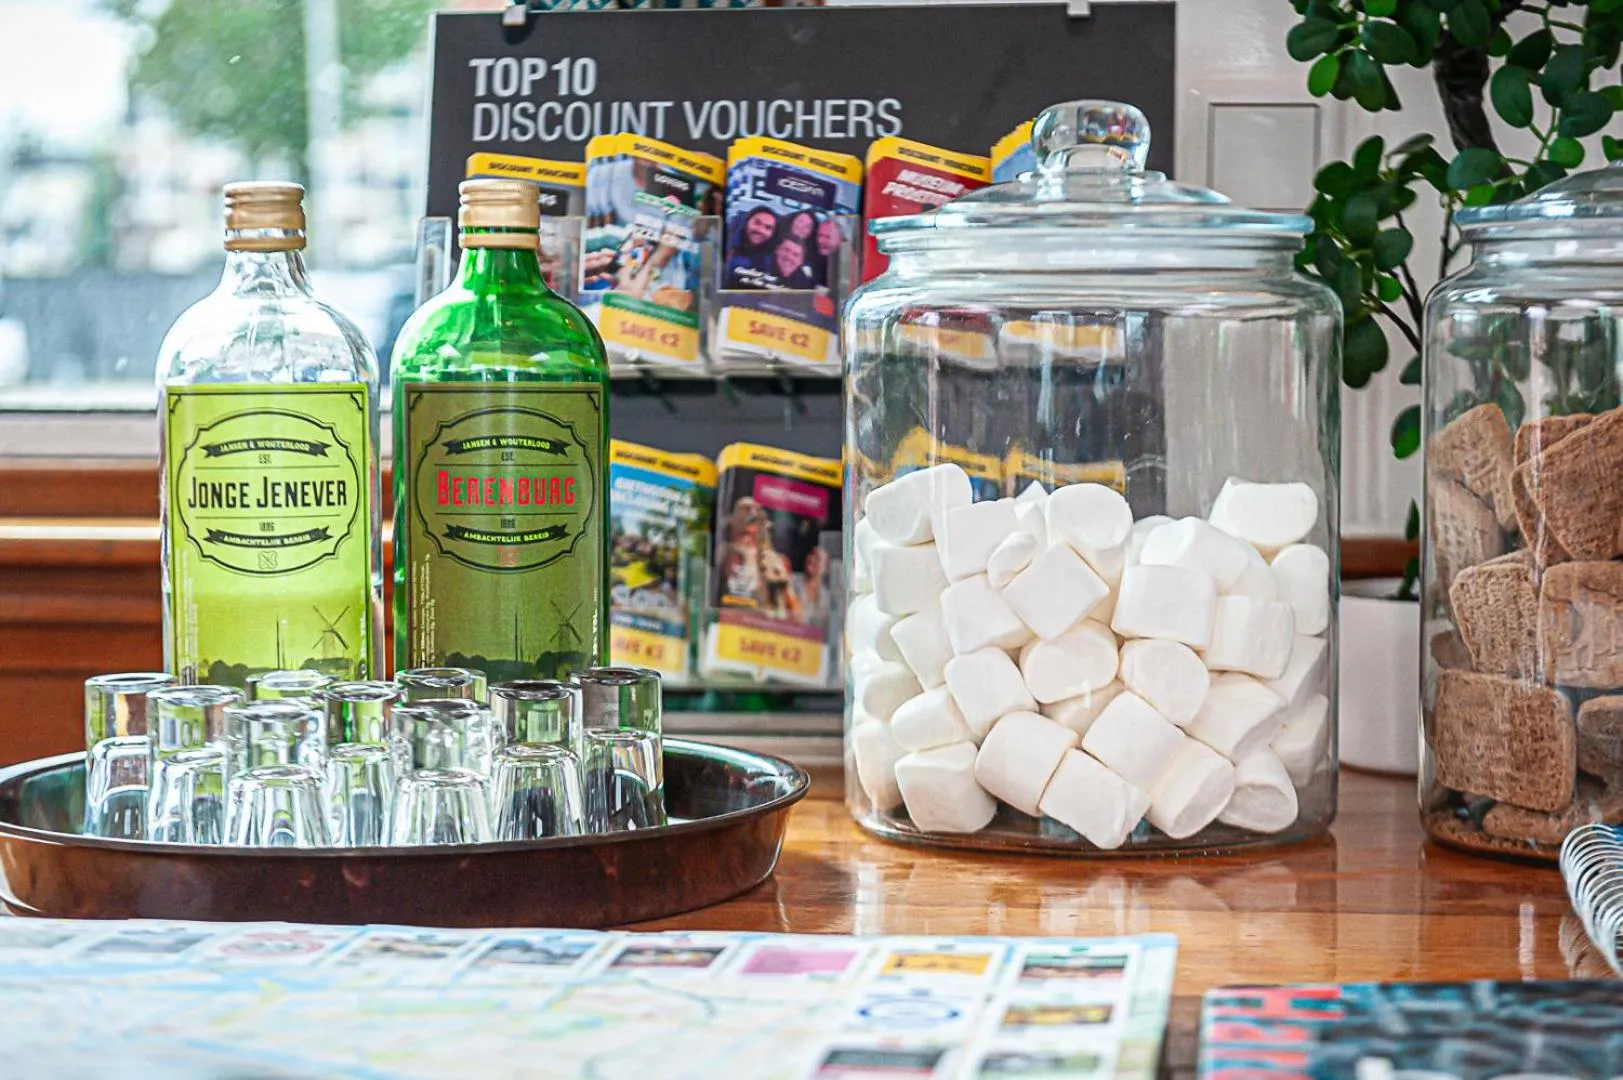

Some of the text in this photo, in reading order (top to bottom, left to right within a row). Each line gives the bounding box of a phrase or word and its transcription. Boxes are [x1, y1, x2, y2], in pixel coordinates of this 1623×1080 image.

[469, 56, 598, 97] TOP 10
[472, 98, 903, 142] DISCOUNT VOUCHERS
[633, 143, 676, 161] DISCOUNT
[762, 145, 805, 162] DISCOUNT
[619, 320, 680, 347] SAVE €2
[749, 320, 810, 347] SAVE €2
[188, 476, 347, 509] JONGE JENEVER
[436, 471, 576, 506] BERENBURG
